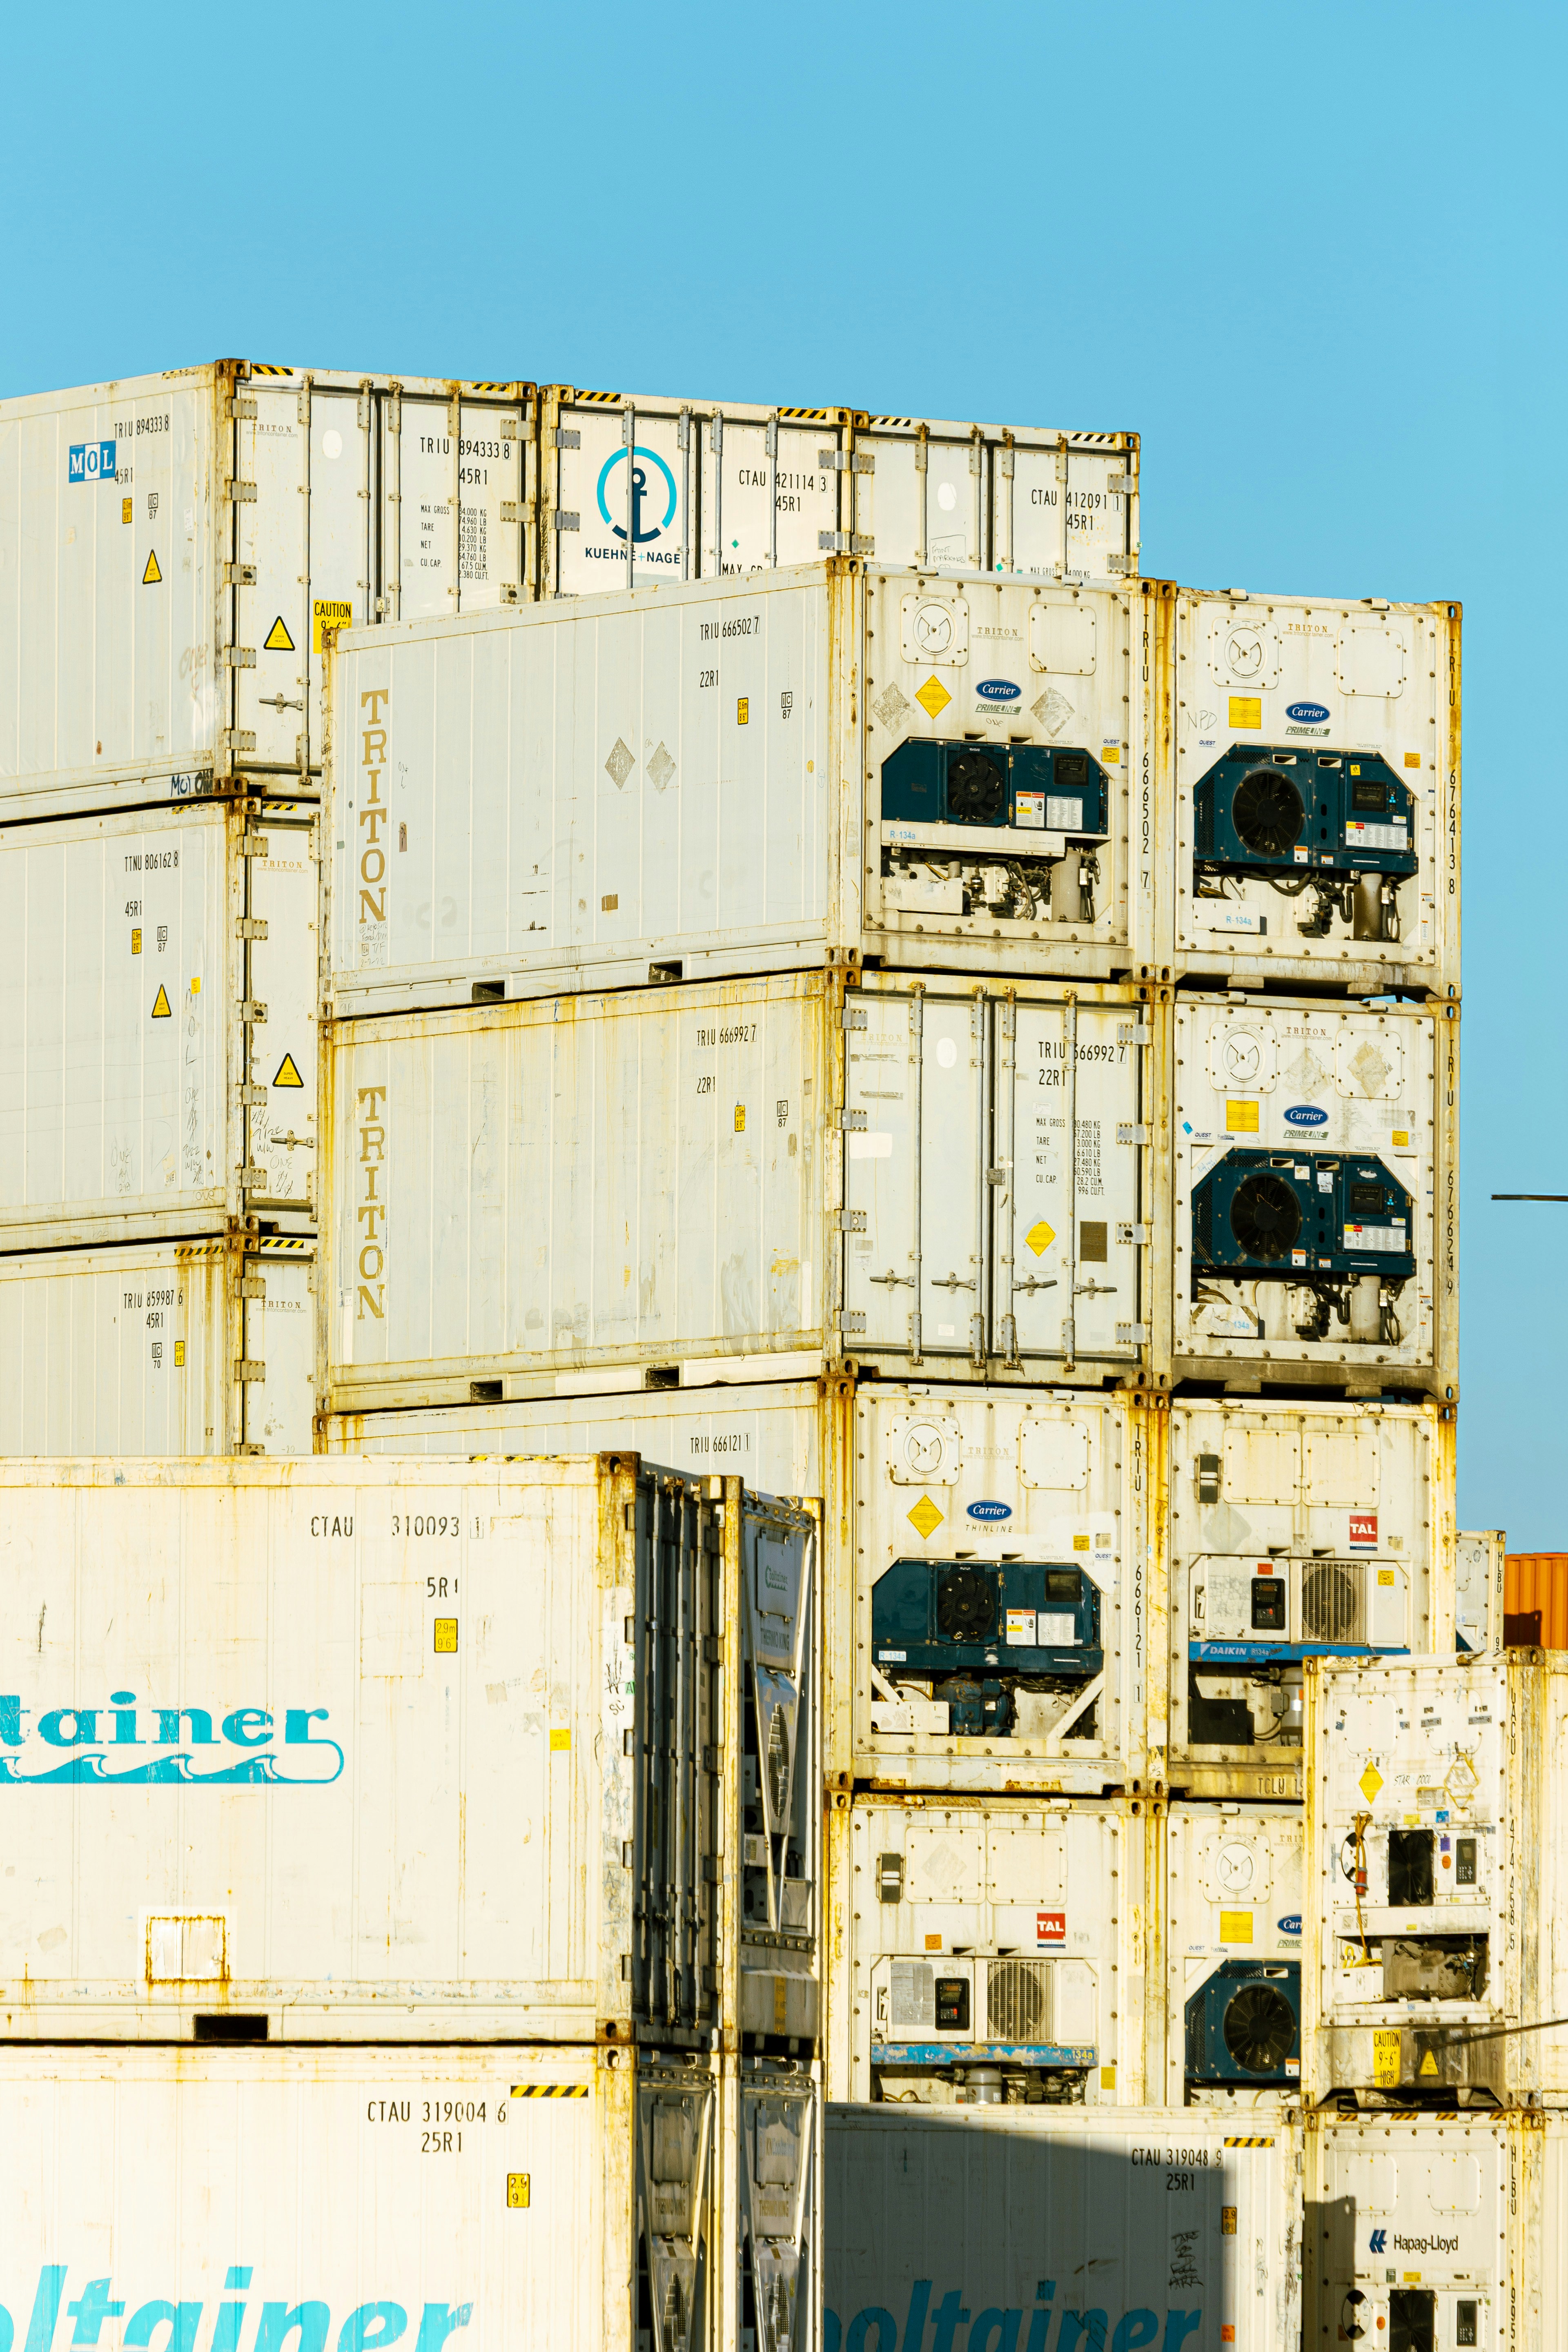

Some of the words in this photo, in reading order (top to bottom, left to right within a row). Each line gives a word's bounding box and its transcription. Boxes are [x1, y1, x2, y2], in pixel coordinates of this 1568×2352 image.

[114, 421, 133, 439] TRIU
[136, 416, 162, 435] 894333
[165, 415, 169, 430] 8
[252, 423, 292, 432] TRITON
[420, 437, 450, 454] TRIU
[459, 440, 500, 458] 894333
[504, 443, 510, 459] 8
[71, 450, 113, 474] MOL
[115, 467, 133, 485] 45R1
[459, 468, 488, 485] 45R1
[739, 470, 766, 486] CTAU
[776, 472, 814, 490] 421114
[821, 477, 826, 491] 3
[776, 495, 800, 512] 45R1
[1032, 489, 1057, 506] CTAU
[1066, 492, 1107, 510] 412091
[149, 510, 156, 519] 87
[421, 505, 431, 513] MAX
[434, 506, 450, 515] GROSS
[480, 509, 487, 517] KG
[480, 517, 487, 526] LB
[1067, 514, 1094, 530] 45R1
[421, 522, 434, 532] TARE
[462, 526, 477, 534] 4.630
[480, 527, 487, 535] KG
[480, 535, 487, 543] LB
[421, 541, 431, 549] NET
[480, 544, 486, 553] KG
[480, 553, 486, 562] LB
[314, 602, 351, 618] CAUTION
[700, 622, 719, 641] TRIU
[722, 618, 751, 637] 666502
[755, 617, 759, 633] 7
[978, 627, 1018, 636] TRITON
[1288, 624, 1328, 633] TRITON
[700, 670, 719, 688] 22R1
[983, 684, 1016, 695] Carrier
[976, 703, 1021, 713] PRIMELINE
[1292, 707, 1325, 717] Carrier
[782, 710, 791, 719] 87
[1286, 726, 1330, 735] PRIMELINE
[359, 689, 388, 924] TRITON
[125, 856, 142, 872] TTNU
[145, 852, 172, 871] 806162
[174, 851, 178, 866] 8
[263, 860, 303, 869] TRITON
[1143, 872, 1148, 888] 7
[1449, 878, 1455, 894] 8
[125, 900, 142, 917] 45R1
[158, 943, 165, 952] 87
[697, 1029, 715, 1046] TRIU
[720, 1026, 748, 1043] 666992
[752, 1025, 756, 1041] 7
[1287, 1027, 1326, 1036] TRITON
[1038, 1042, 1065, 1058] TRIU
[1074, 1043, 1114, 1062] 666992
[1119, 1046, 1125, 1062] 7
[1039, 1069, 1065, 1087] 22R1
[697, 1076, 715, 1094] 22R1
[1290, 1110, 1323, 1121] Carrier
[778, 1118, 786, 1127] 87
[1036, 1118, 1046, 1127] MAX
[1050, 1119, 1065, 1127] GROSS
[1094, 1120, 1100, 1129] KG
[1094, 1130, 1100, 1139] LB
[1284, 1129, 1328, 1138] PRIMELINE
[1036, 1136, 1050, 1146] TARE
[1077, 1139, 1092, 1148] 3.000
[1094, 1140, 1100, 1148] KG
[1077, 1148, 1092, 1157] 6.610
[1094, 1149, 1100, 1158] LB
[1036, 1156, 1047, 1165] NET
[1094, 1158, 1100, 1167] KG
[1094, 1168, 1100, 1176] LB
[1078, 1187, 1088, 1195] 996
[357, 1085, 386, 1320] TRITON
[124, 1292, 142, 1309] TRIU
[147, 1290, 174, 1307] 859987
[178, 1289, 183, 1305] 6
[147, 1312, 163, 1329] 45R1
[154, 1361, 161, 1369] 70
[690, 1436, 709, 1454] TRIU
[713, 1434, 741, 1452] 666121
[969, 1447, 1009, 1456] TRITON
[973, 1505, 1007, 1515] Carrier
[311, 1517, 353, 1537] CTAU
[1350, 1523, 1376, 1535] TAL
[1209, 1646, 1247, 1656] DAIKIN
[1394, 1775, 1410, 1786] STAR
[1038, 1921, 1064, 1931] TAL
[1374, 2032, 1400, 2047] CAUTION
[1380, 2070, 1394, 2085] HIGH
[368, 2102, 410, 2122] CTAU
[422, 2102, 486, 2122] 319004
[498, 2102, 506, 2122] 6
[421, 2132, 462, 2152] 25R1
[1132, 2148, 1160, 2166] CTAU
[1166, 2148, 1208, 2167] 319048
[1167, 2173, 1195, 2192] 25R1
[1394, 2234, 1458, 2254] Hapag-Lloyd
